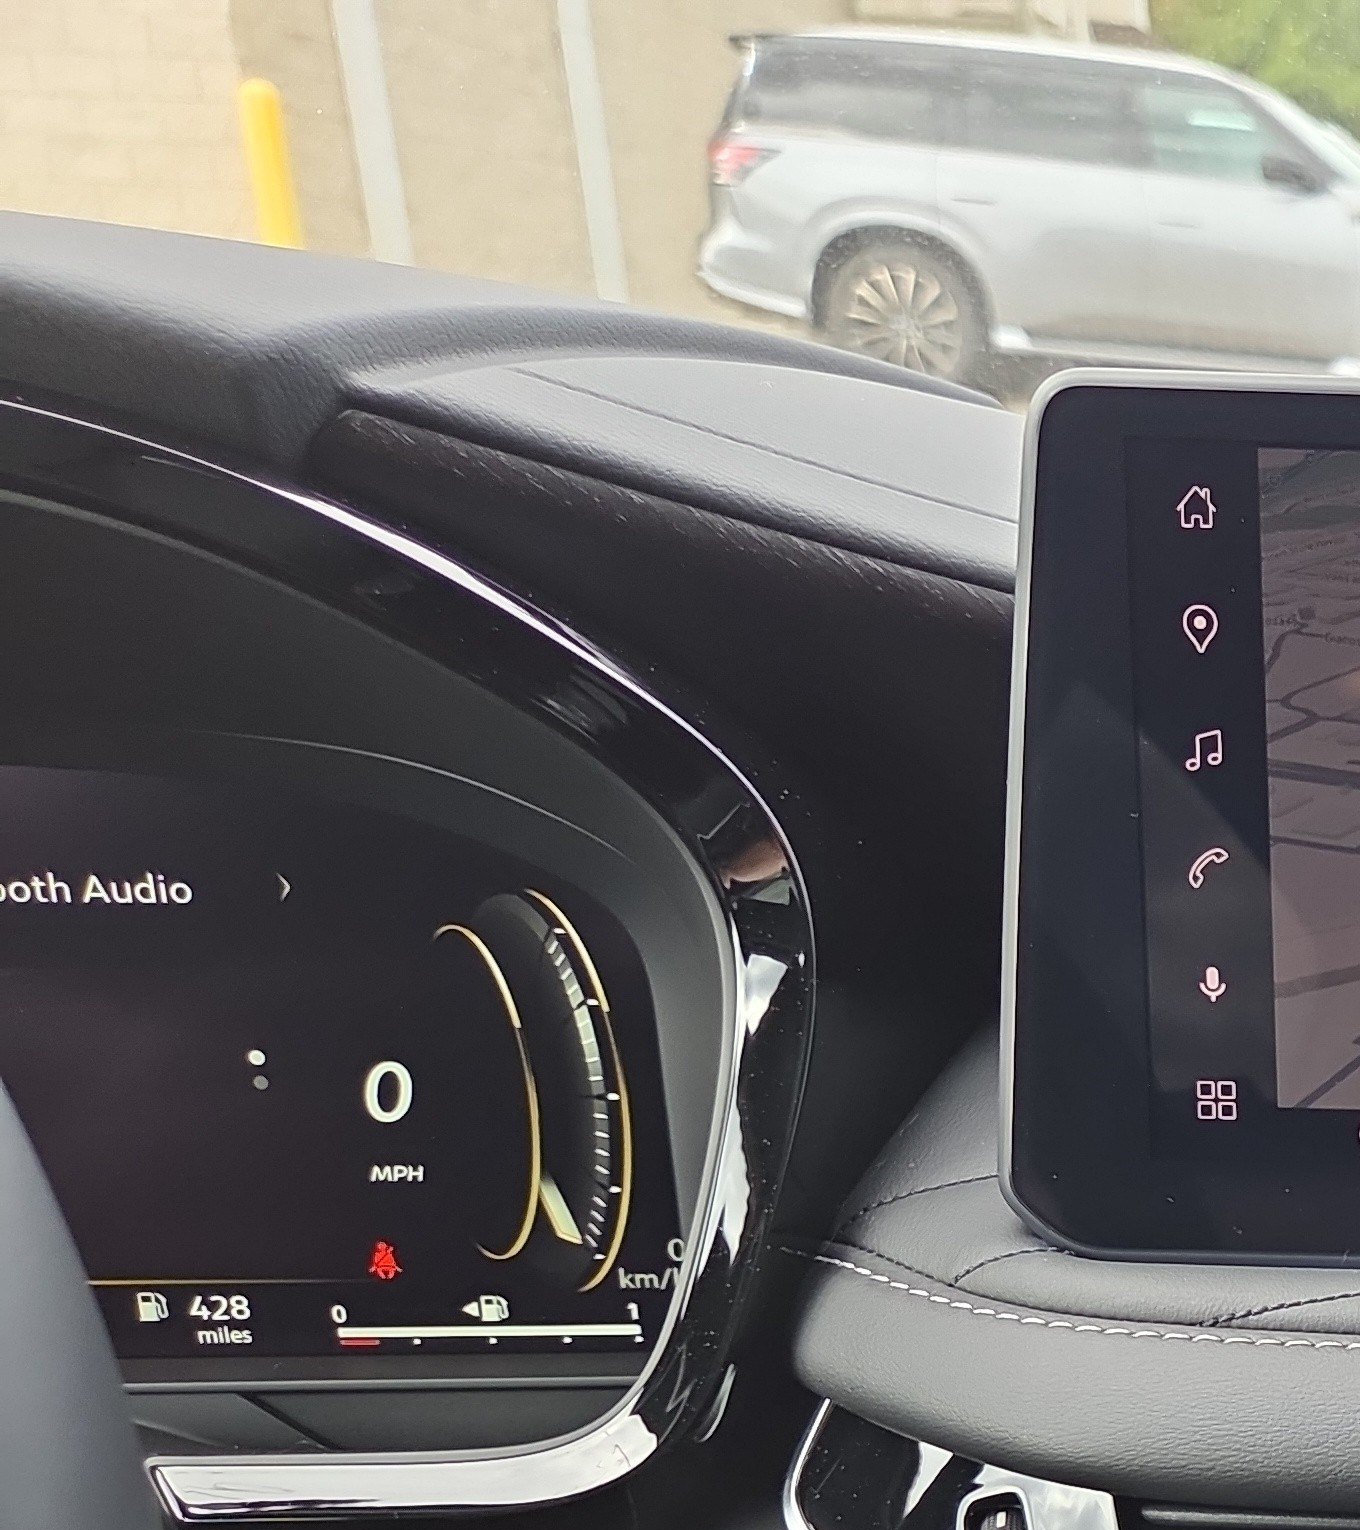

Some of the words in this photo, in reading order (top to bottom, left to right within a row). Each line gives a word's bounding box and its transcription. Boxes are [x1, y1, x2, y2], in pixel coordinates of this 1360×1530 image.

[0, 871, 72, 903] oth
[82, 870, 193, 904] Audio
[365, 1060, 413, 1123] 0
[370, 1164, 425, 1182] MPH
[189, 1294, 251, 1321] 428
[330, 1304, 348, 1324] 0
[626, 1301, 640, 1321] 1
[197, 1325, 253, 1345] miles
